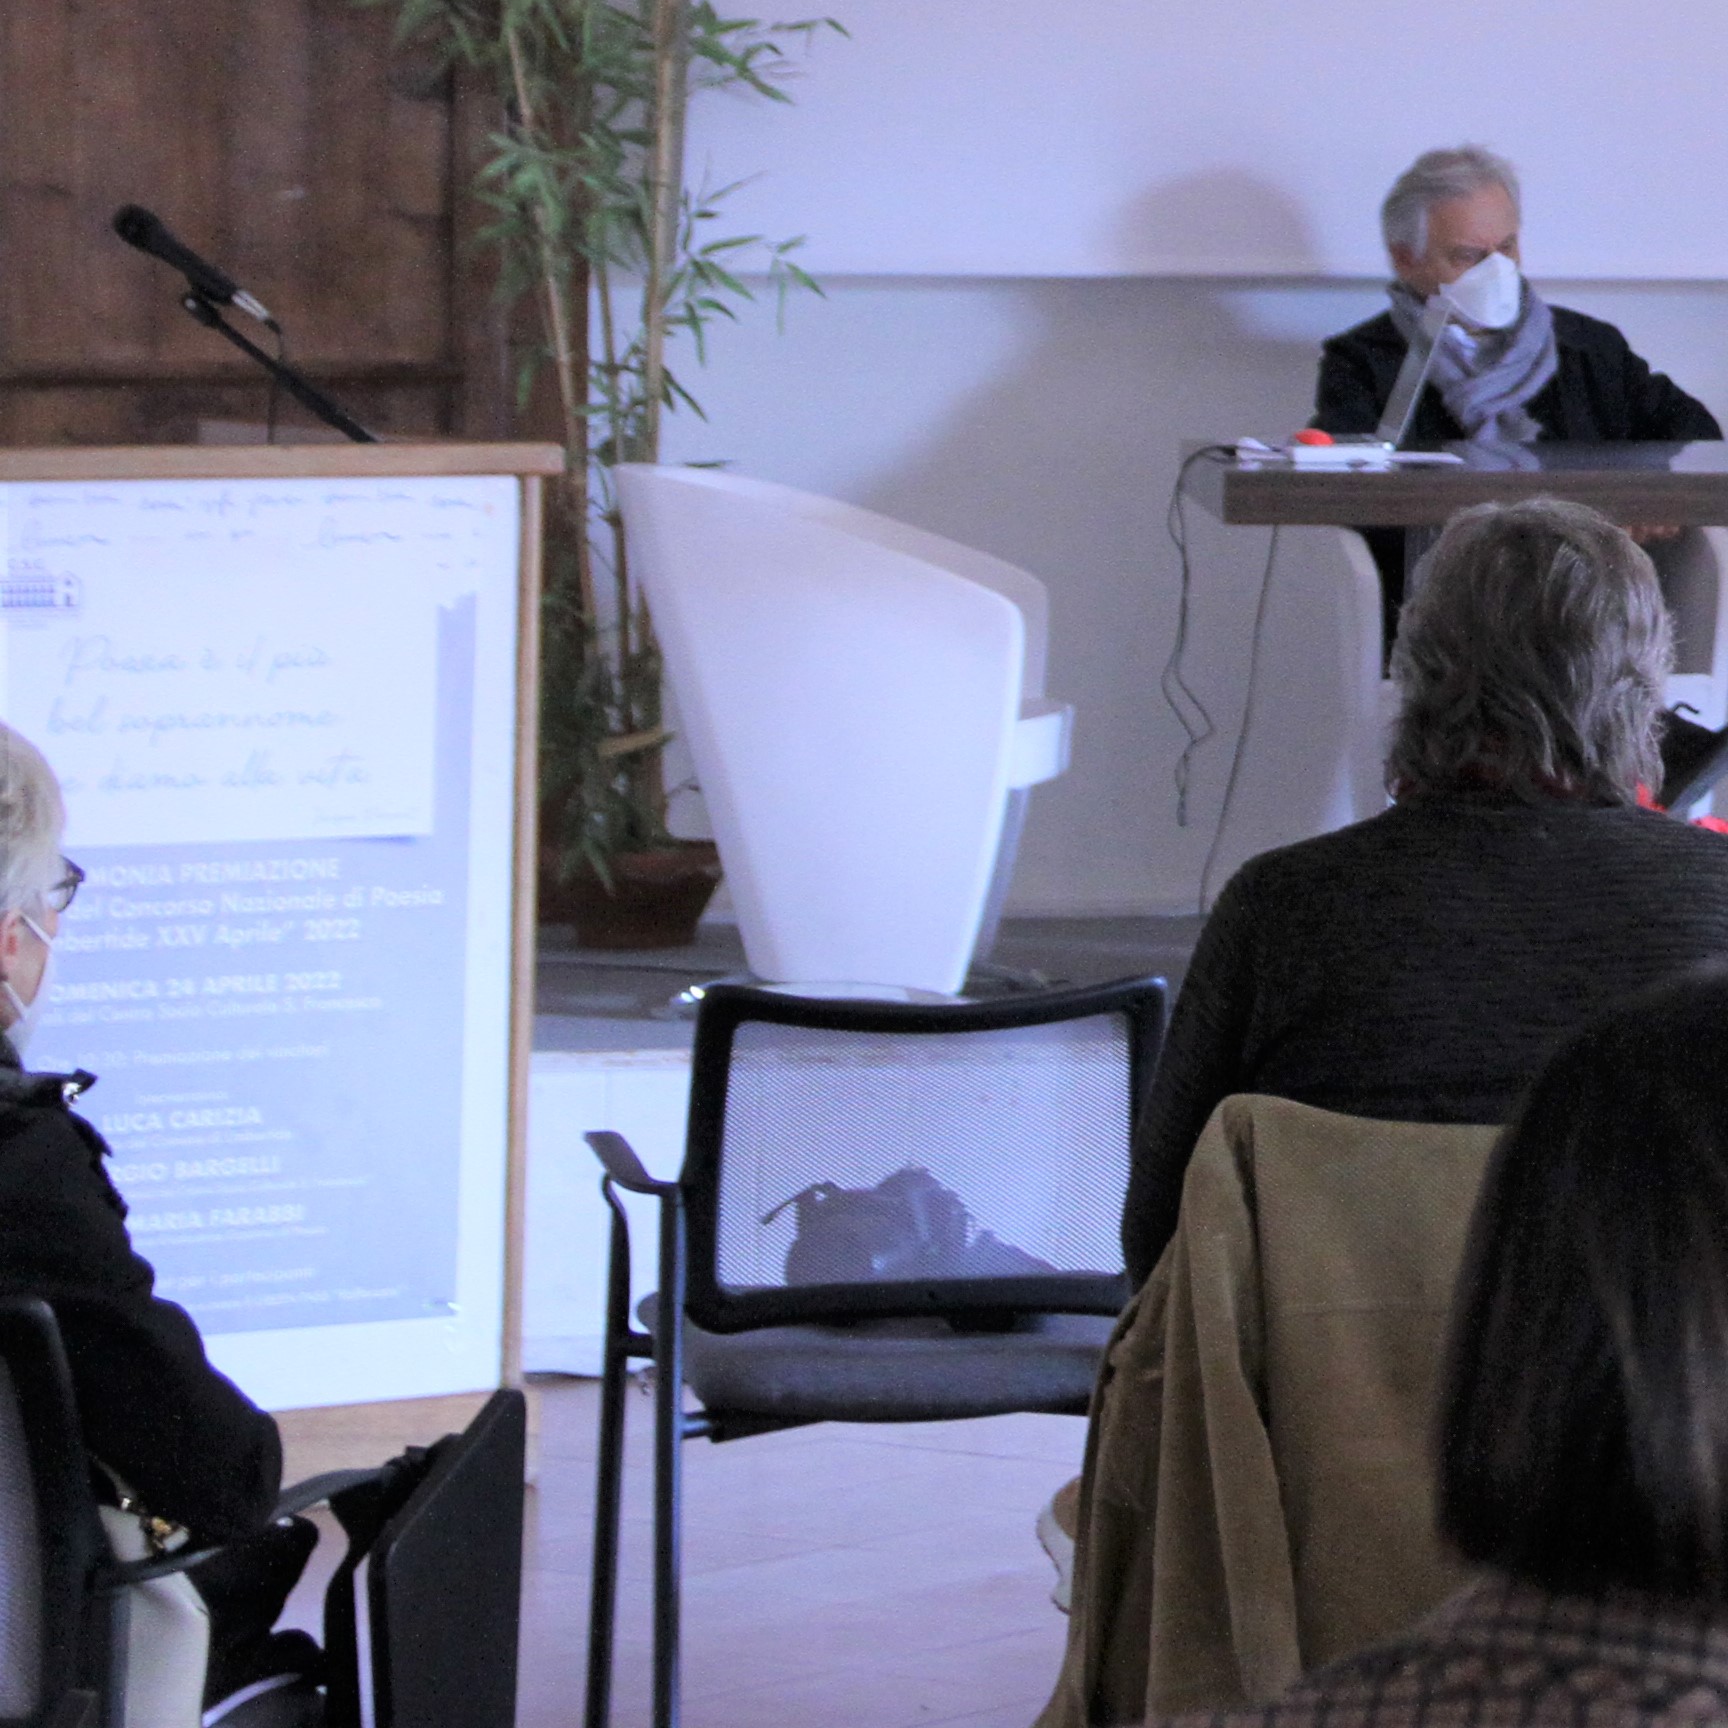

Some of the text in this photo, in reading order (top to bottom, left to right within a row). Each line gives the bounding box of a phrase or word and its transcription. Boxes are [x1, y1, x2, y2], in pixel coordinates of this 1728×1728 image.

[46, 693, 109, 736] bel
[87, 856, 341, 888] MONIA PREMIAZIONE
[109, 895, 216, 919] Concorso
[220, 888, 337, 914] Nazionale
[341, 885, 365, 909] di
[370, 883, 447, 907] Poesia
[51, 927, 151, 952] mbertide
[156, 923, 208, 948] XXV
[303, 917, 362, 943] 2022
[49, 970, 343, 1004] OMENICA 24 APRILE 2022
[101, 1105, 265, 1134] LUCA CARIZIA
[109, 1162, 170, 1183] RGIO
